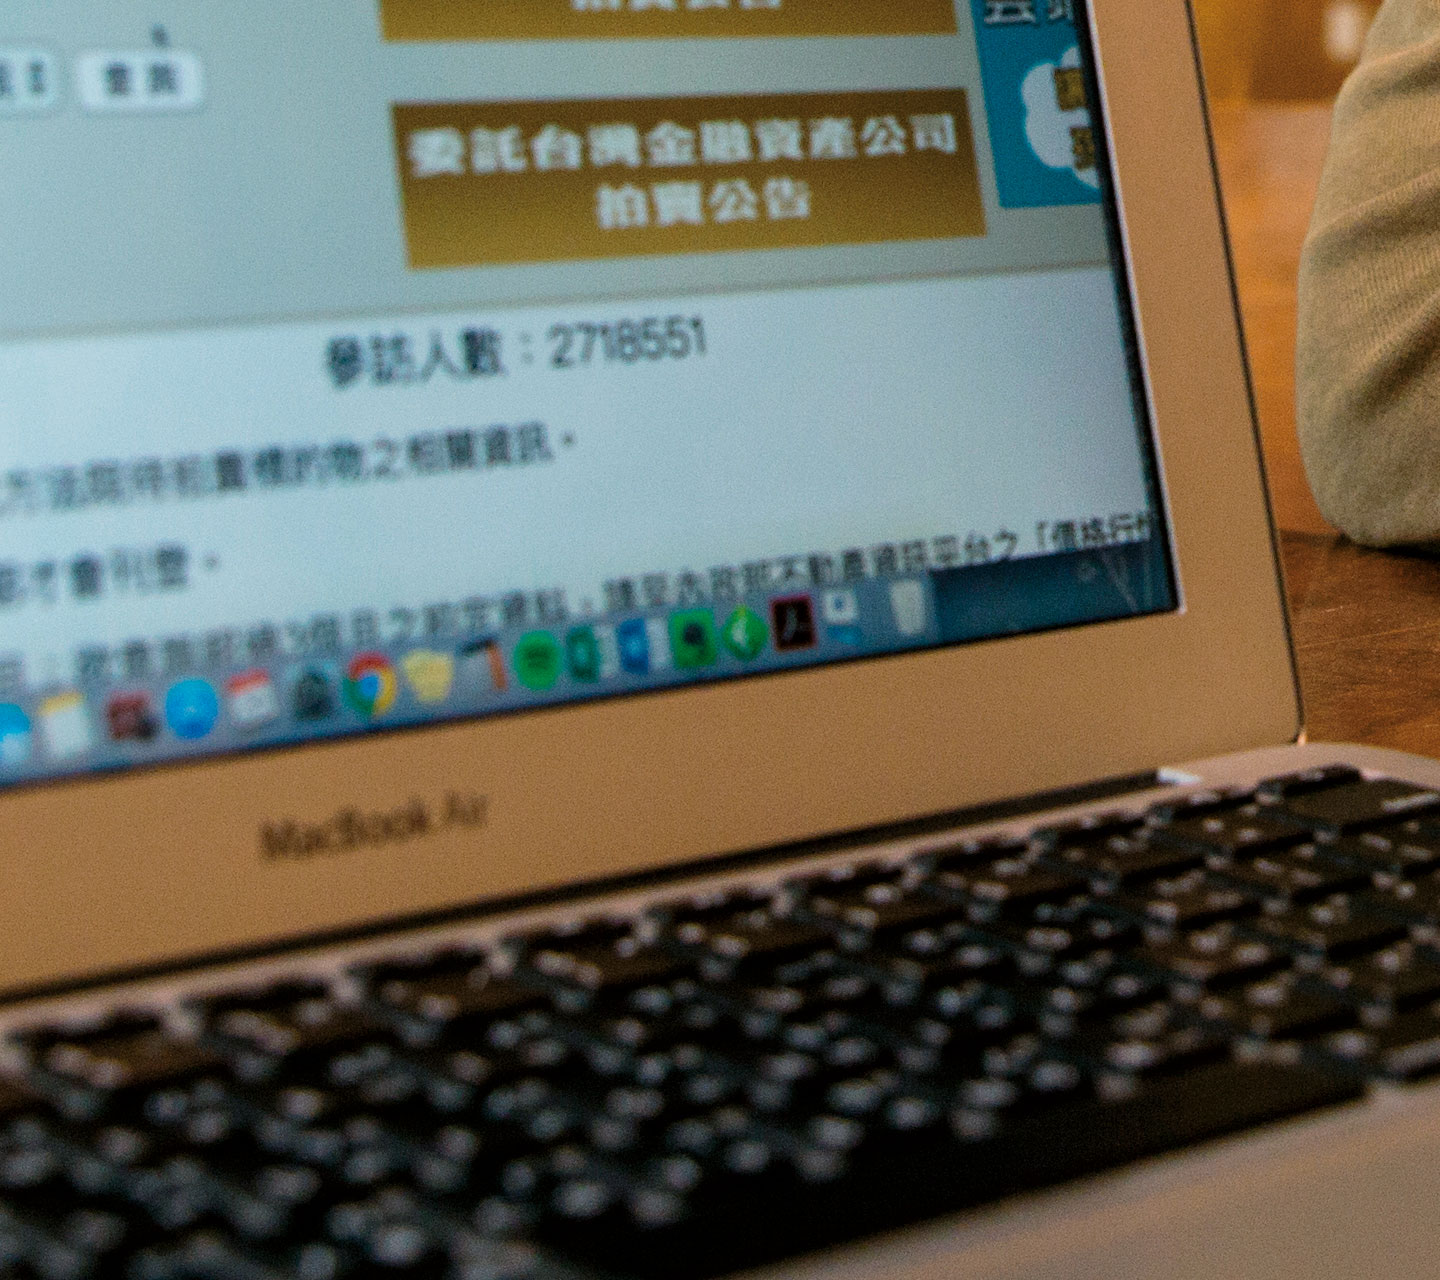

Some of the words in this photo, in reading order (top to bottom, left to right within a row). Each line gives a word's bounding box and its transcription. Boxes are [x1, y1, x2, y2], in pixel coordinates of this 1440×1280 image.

[409, 113, 957, 178] 委託台灣金融資產公司
[597, 177, 810, 229] 拍賣公告
[260, 796, 428, 862] MacBook
[444, 789, 490, 828] Air
